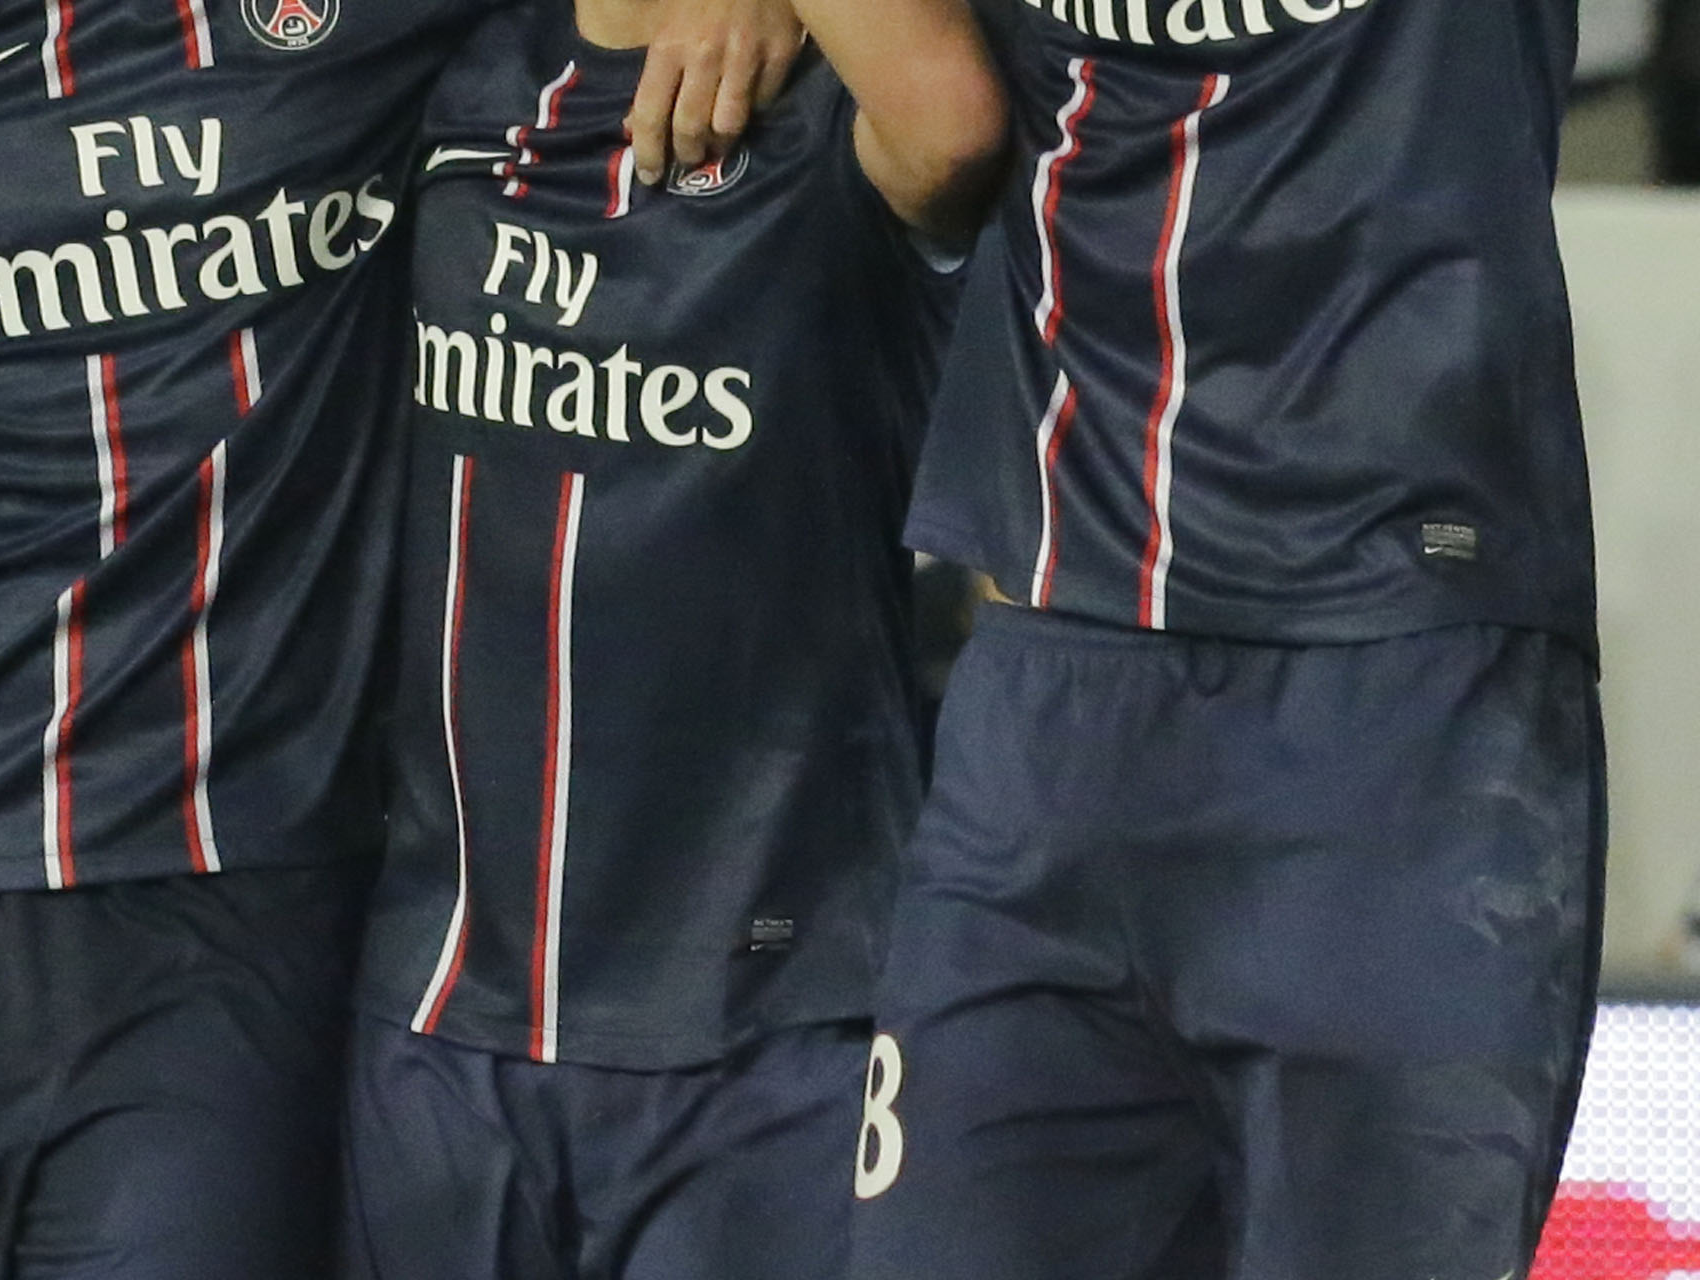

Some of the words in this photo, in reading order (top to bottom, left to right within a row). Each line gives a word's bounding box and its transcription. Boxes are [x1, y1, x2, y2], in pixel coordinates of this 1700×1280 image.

[70, 114, 223, 198] Fly
[482, 221, 599, 328] Fly
[413, 306, 753, 451] mirates
